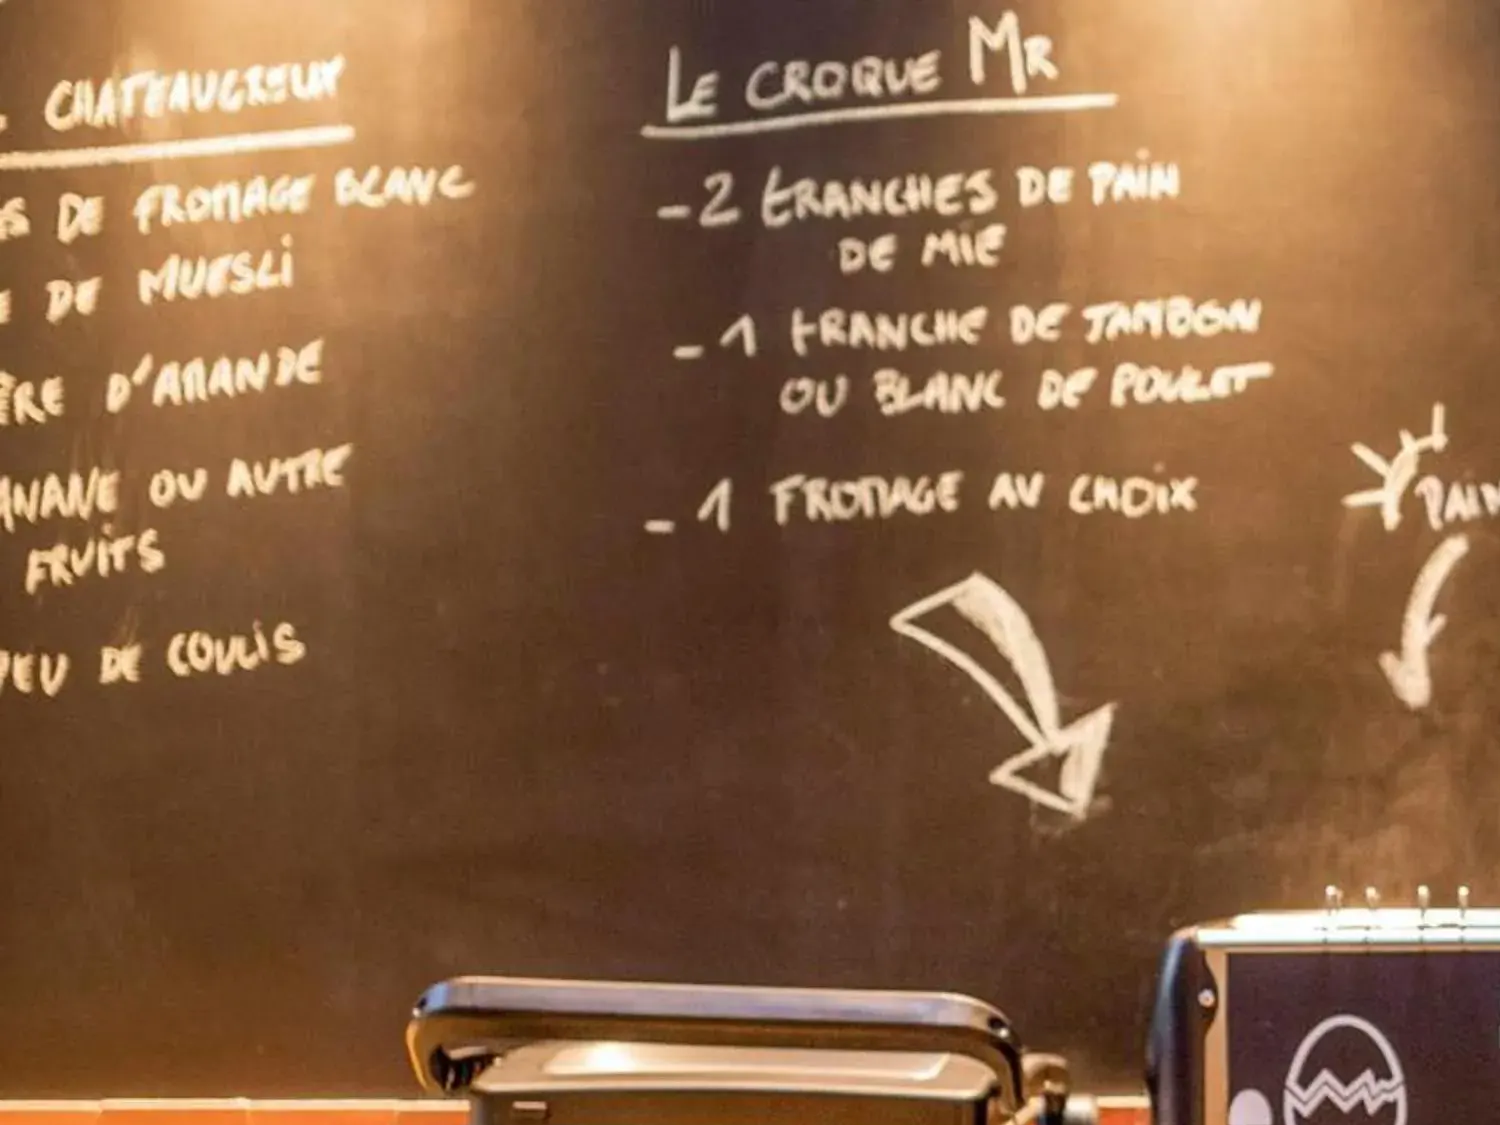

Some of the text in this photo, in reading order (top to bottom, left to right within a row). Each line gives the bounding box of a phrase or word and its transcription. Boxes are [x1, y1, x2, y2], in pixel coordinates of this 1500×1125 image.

[745, 49, 943, 110] CROQUE
[57, 192, 104, 243] DE
[134, 174, 316, 235] FROMAGE
[334, 165, 477, 209] BLANC
[1015, 165, 1075, 208] DE
[837, 233, 897, 276] DE
[46, 276, 102, 325] DE
[1010, 303, 1071, 345] DE
[1083, 297, 1262, 344] JAMBON
[780, 361, 1275, 418] OU BLANC DE POULET
[150, 467, 208, 509] OU
[226, 442, 354, 498] AUTRE
[771, 470, 964, 527] FROMAGE
[988, 472, 1045, 512] AU
[99, 644, 142, 686] DE
